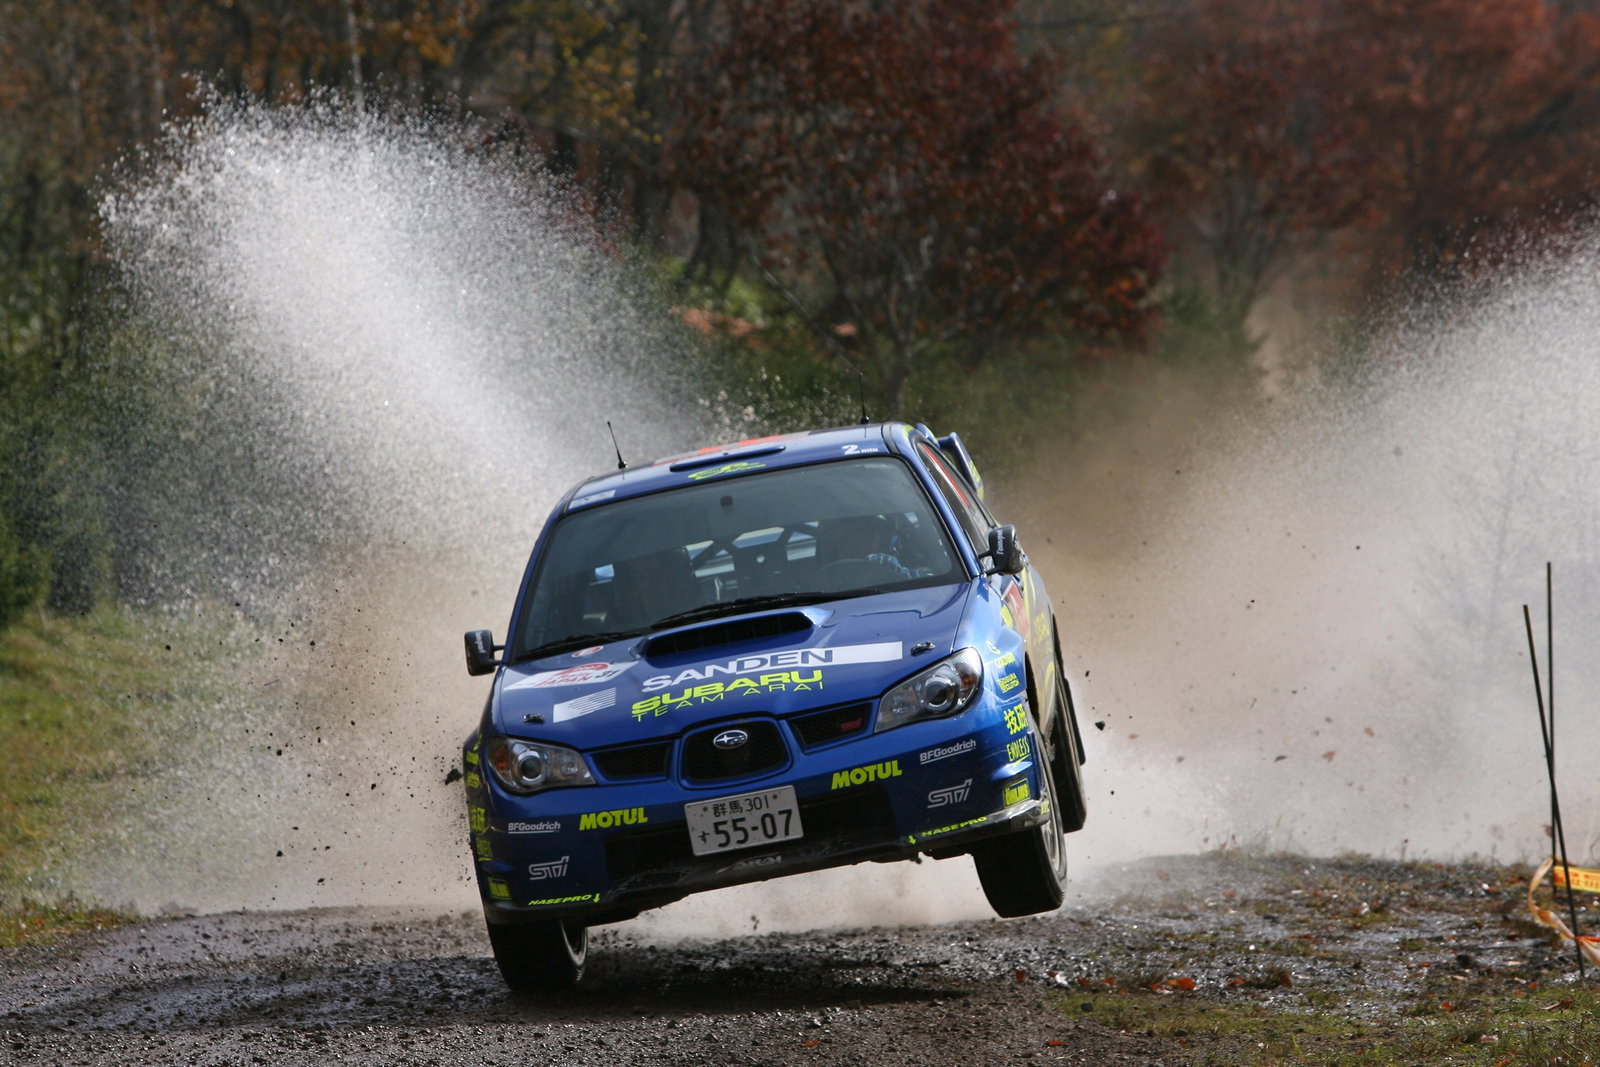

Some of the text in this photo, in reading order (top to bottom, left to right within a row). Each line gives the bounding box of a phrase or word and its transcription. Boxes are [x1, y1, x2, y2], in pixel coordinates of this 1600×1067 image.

[842, 444, 860, 455] 2
[641, 649, 833, 693] SANDEN
[631, 669, 823, 714] SUBARU
[631, 681, 824, 722] TEAM ARAI
[919, 739, 977, 762] BFGoodrich
[831, 760, 902, 790] MOTUL
[507, 821, 561, 831] BFGoodrich
[579, 807, 648, 831] MOTUL
[713, 809, 792, 848] 55-07
[921, 816, 988, 837] HASEPRO
[528, 894, 592, 906] HASEPRO
